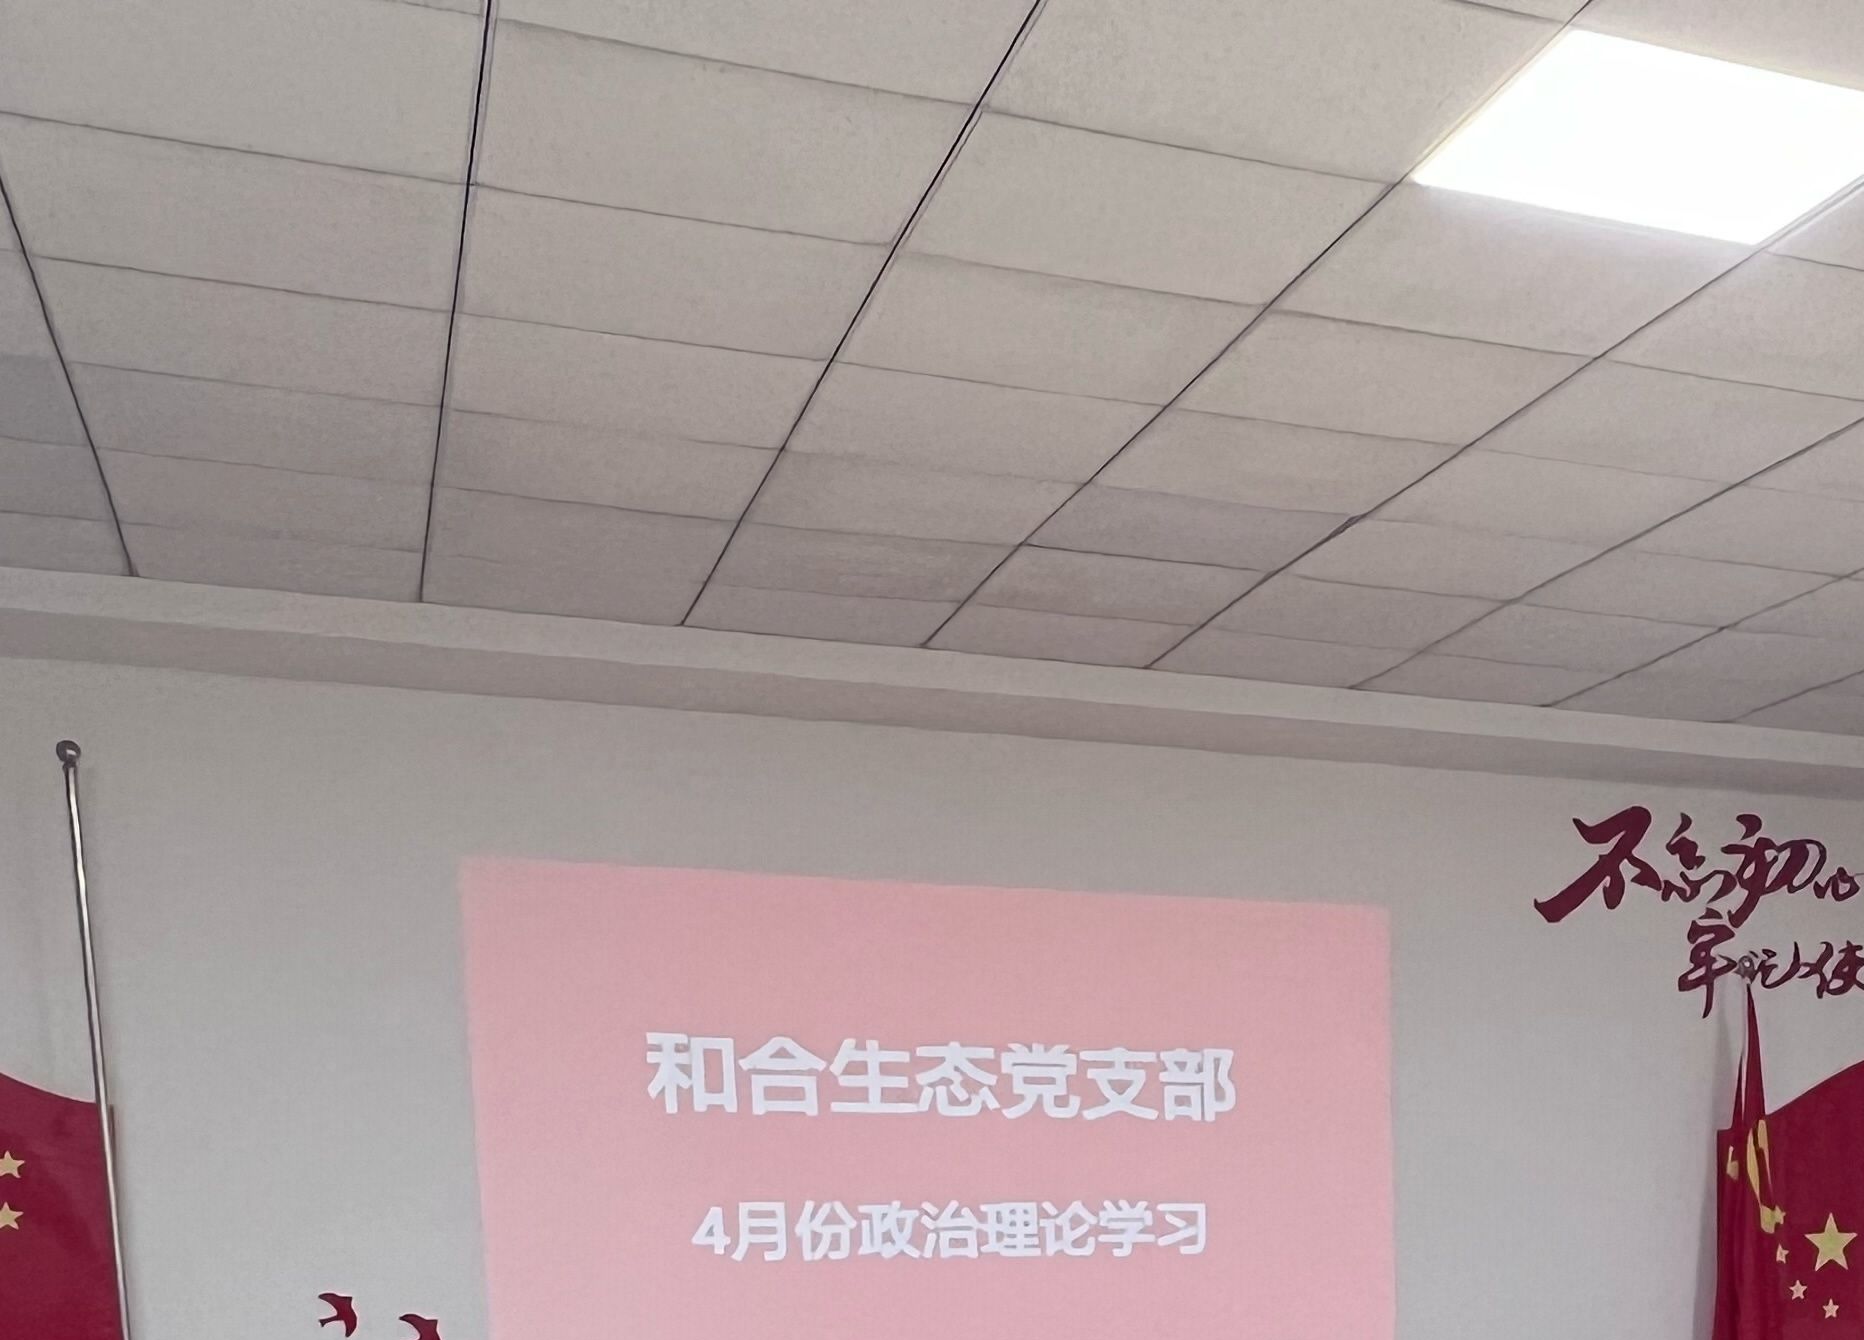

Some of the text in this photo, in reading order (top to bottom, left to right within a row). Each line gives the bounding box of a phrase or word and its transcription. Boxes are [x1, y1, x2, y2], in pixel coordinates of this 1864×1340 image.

[646, 1031, 1237, 1122] 和合生态党支部
[691, 1199, 1207, 1261] 4月份政治理论学习
